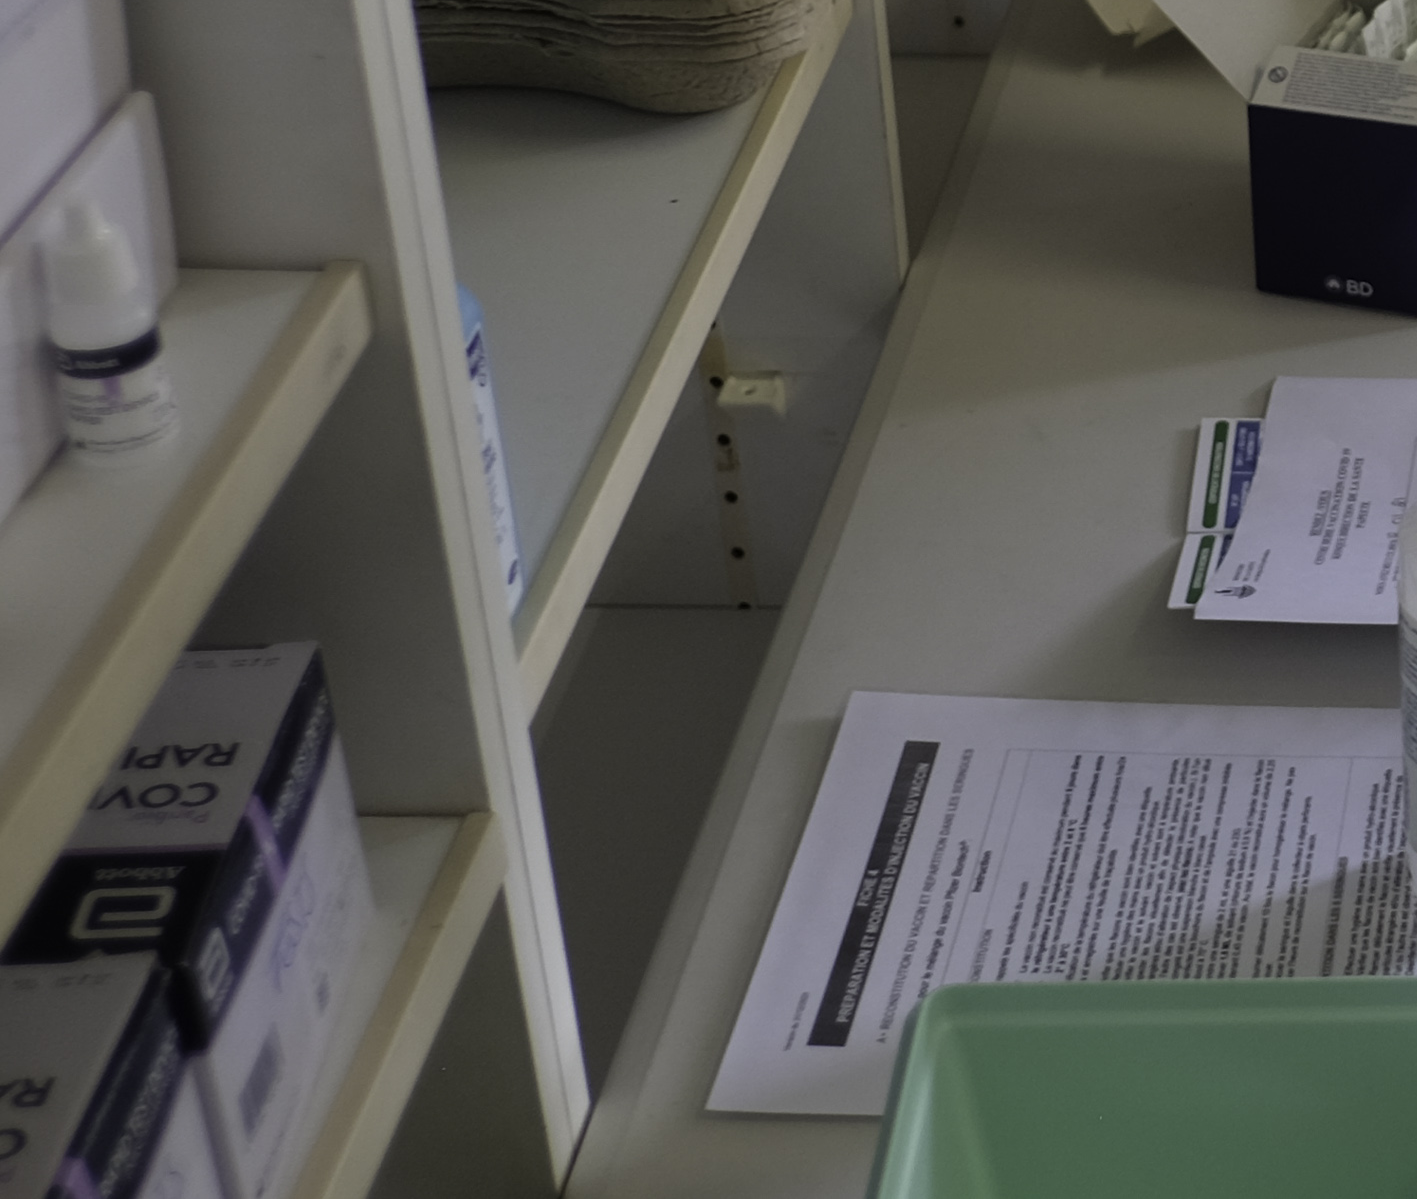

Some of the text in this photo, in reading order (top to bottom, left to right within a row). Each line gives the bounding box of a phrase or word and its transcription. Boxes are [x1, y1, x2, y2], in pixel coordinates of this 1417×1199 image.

[1345, 279, 1374, 298] BD
[120, 740, 241, 771] RAPI
[947, 796, 961, 811] LES
[940, 813, 956, 835] DANS
[94, 864, 186, 883] Abbott
[973, 850, 993, 892] Instruction
[836, 762, 932, 1022] PREPARATION ET MODALITES D'INJECTION DU VACCIN
[856, 878, 878, 906] FICHE
[918, 893, 932, 904] ET
[908, 906, 928, 937] VACCIN
[937, 901, 955, 924] vaccin
[904, 939, 918, 951] DU
[880, 953, 913, 1029] RECONSTITUTION
